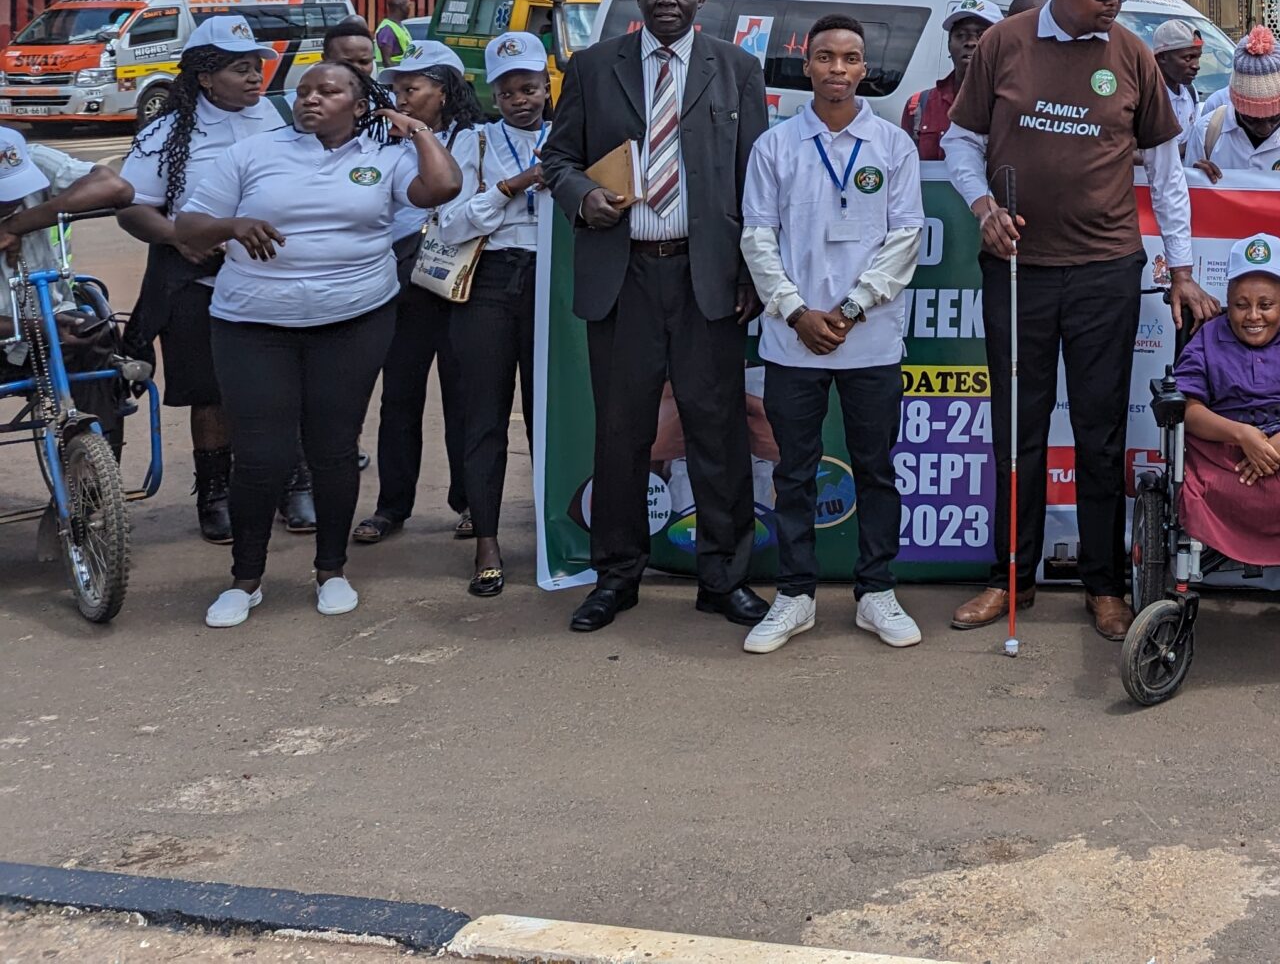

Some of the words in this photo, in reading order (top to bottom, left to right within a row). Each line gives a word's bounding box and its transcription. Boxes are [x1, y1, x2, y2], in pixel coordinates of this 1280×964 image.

[134, 45, 169, 57] HIGHER
[14, 54, 63, 68] SWAT
[1035, 100, 1090, 119] FAMILY
[1019, 115, 1102, 137] INCLUSION
[1138, 318, 1164, 340] ry's
[1135, 340, 1164, 348] SPITAL
[893, 452, 988, 496] SEPT
[648, 485, 665, 495] ght
[649, 510, 669, 520] lief
[899, 504, 989, 547] 2023
